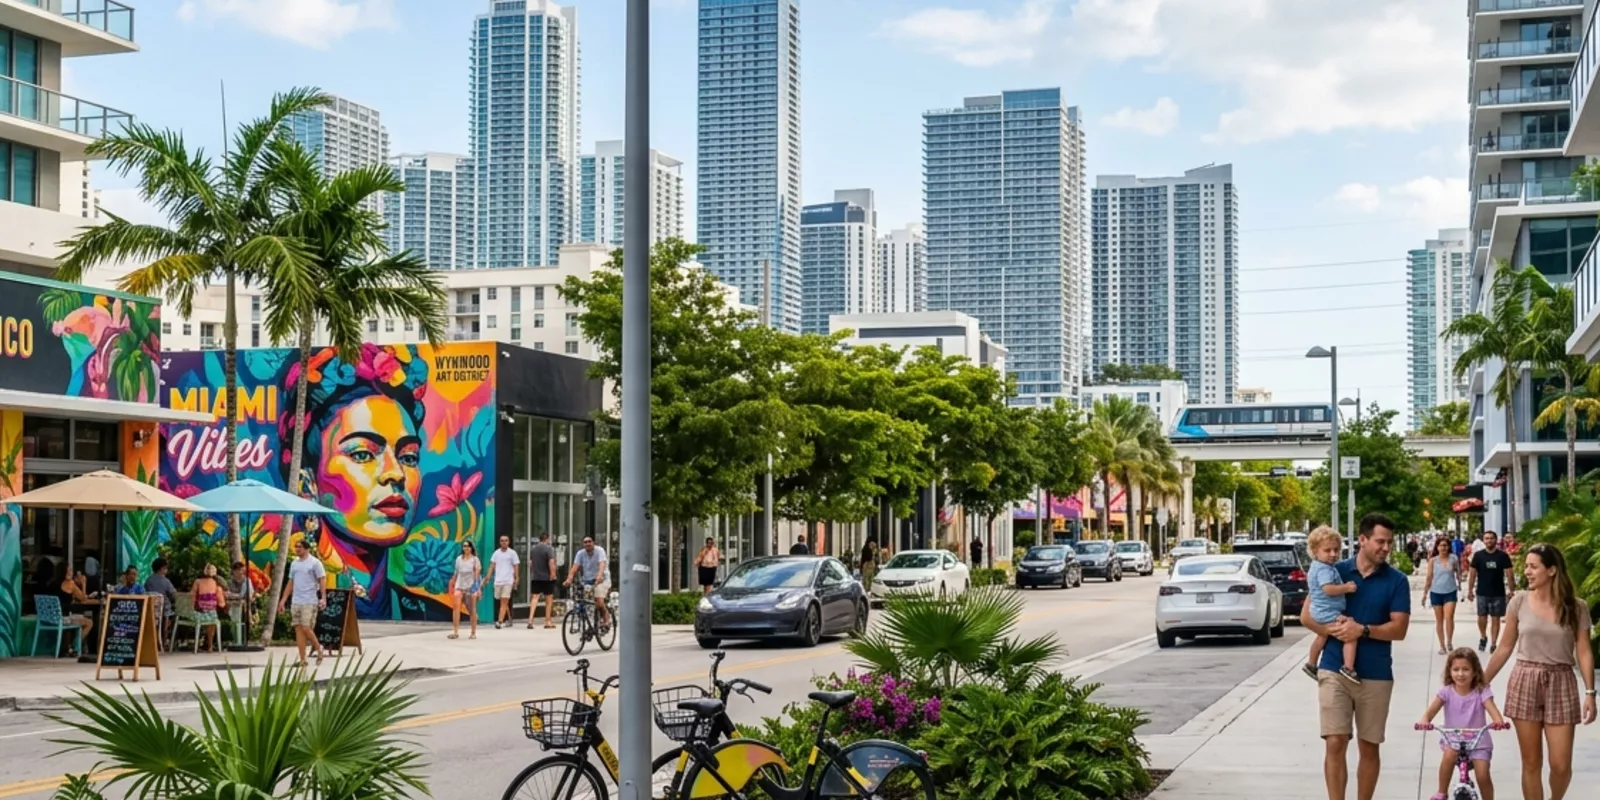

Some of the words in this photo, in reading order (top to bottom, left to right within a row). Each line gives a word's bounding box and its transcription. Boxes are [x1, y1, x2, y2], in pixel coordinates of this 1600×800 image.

[436, 370, 451, 382] ART
[169, 385, 278, 423] MIAMI
[167, 426, 273, 479] Vibes
